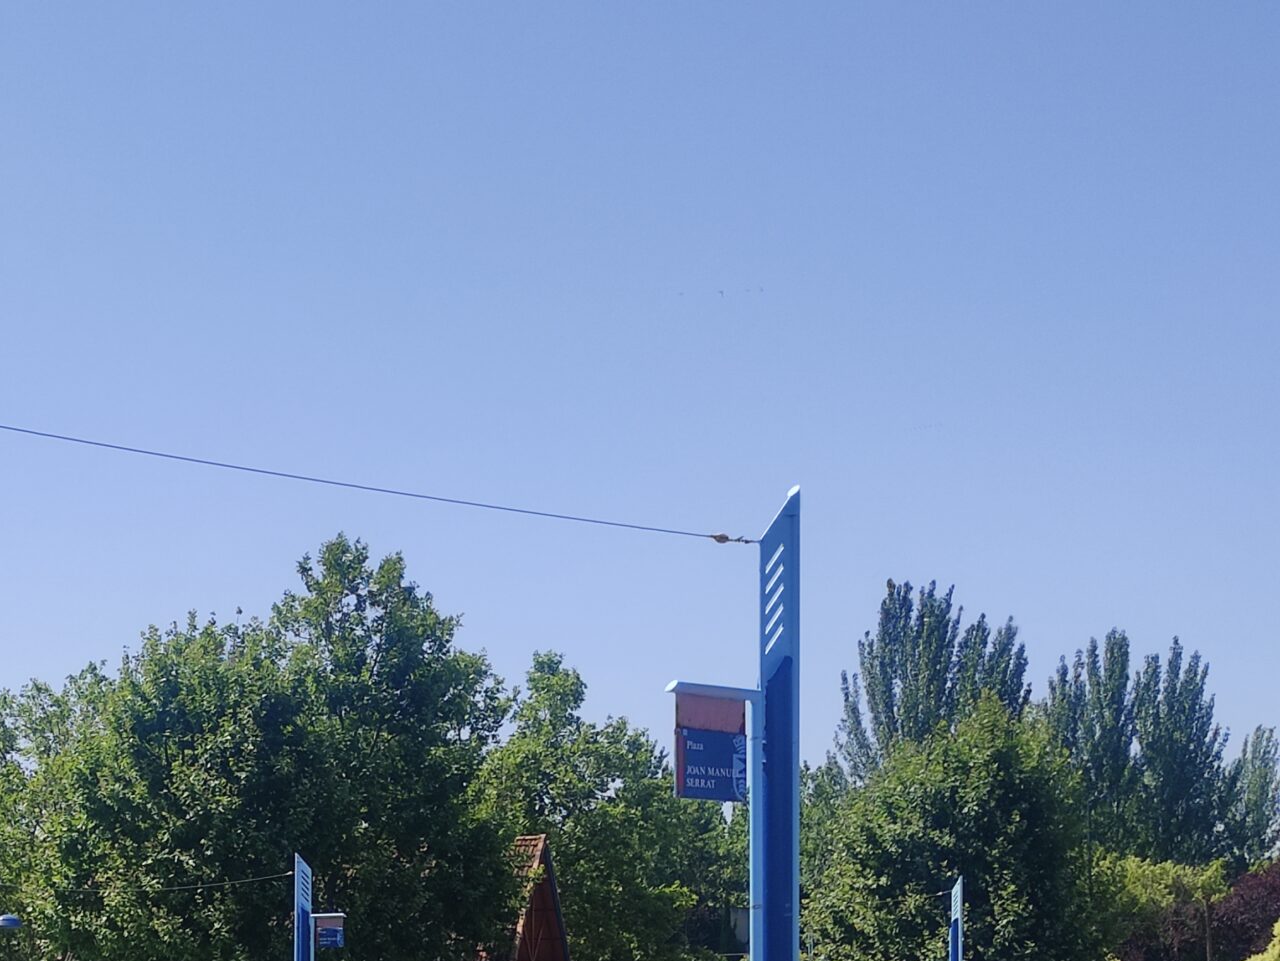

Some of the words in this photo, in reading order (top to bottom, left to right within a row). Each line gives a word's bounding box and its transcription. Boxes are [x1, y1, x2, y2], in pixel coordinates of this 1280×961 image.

[686, 740, 704, 750] Plaza
[686, 765, 706, 775] JOAN
[707, 767, 740, 778] MANU
[686, 778, 715, 788] SERRAT
